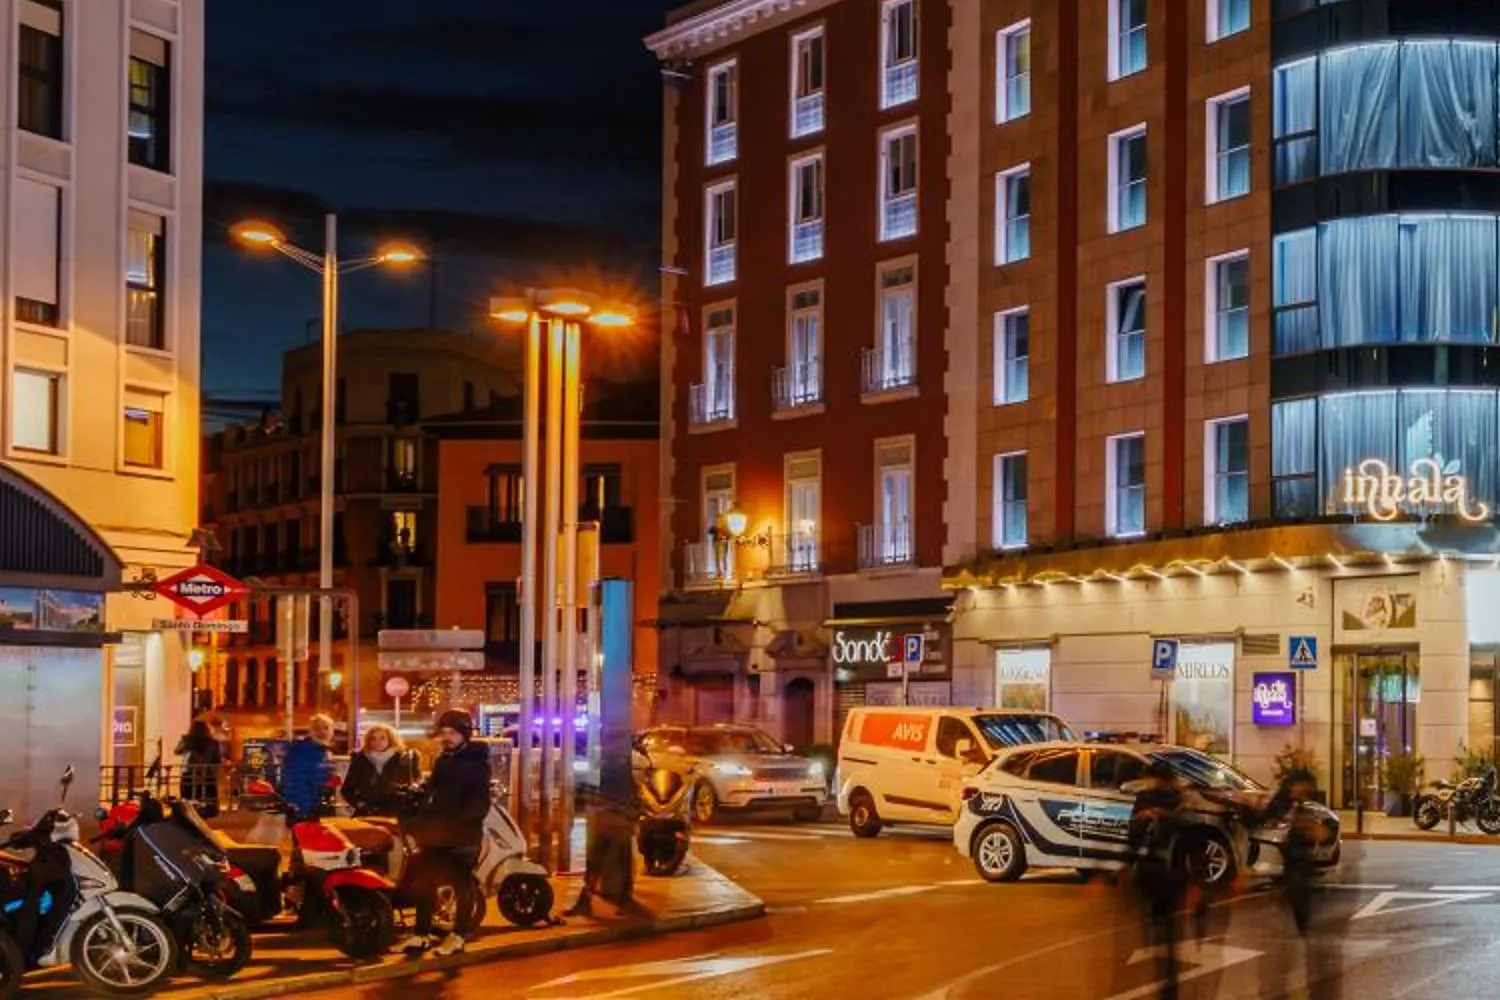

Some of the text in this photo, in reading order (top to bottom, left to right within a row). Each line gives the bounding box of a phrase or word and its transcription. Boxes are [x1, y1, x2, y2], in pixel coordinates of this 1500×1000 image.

[1344, 458, 1489, 521] inhala
[179, 582, 222, 596] Metro
[907, 637, 918, 659] P
[1156, 642, 1172, 666] P
[892, 723, 926, 742] AVIS
